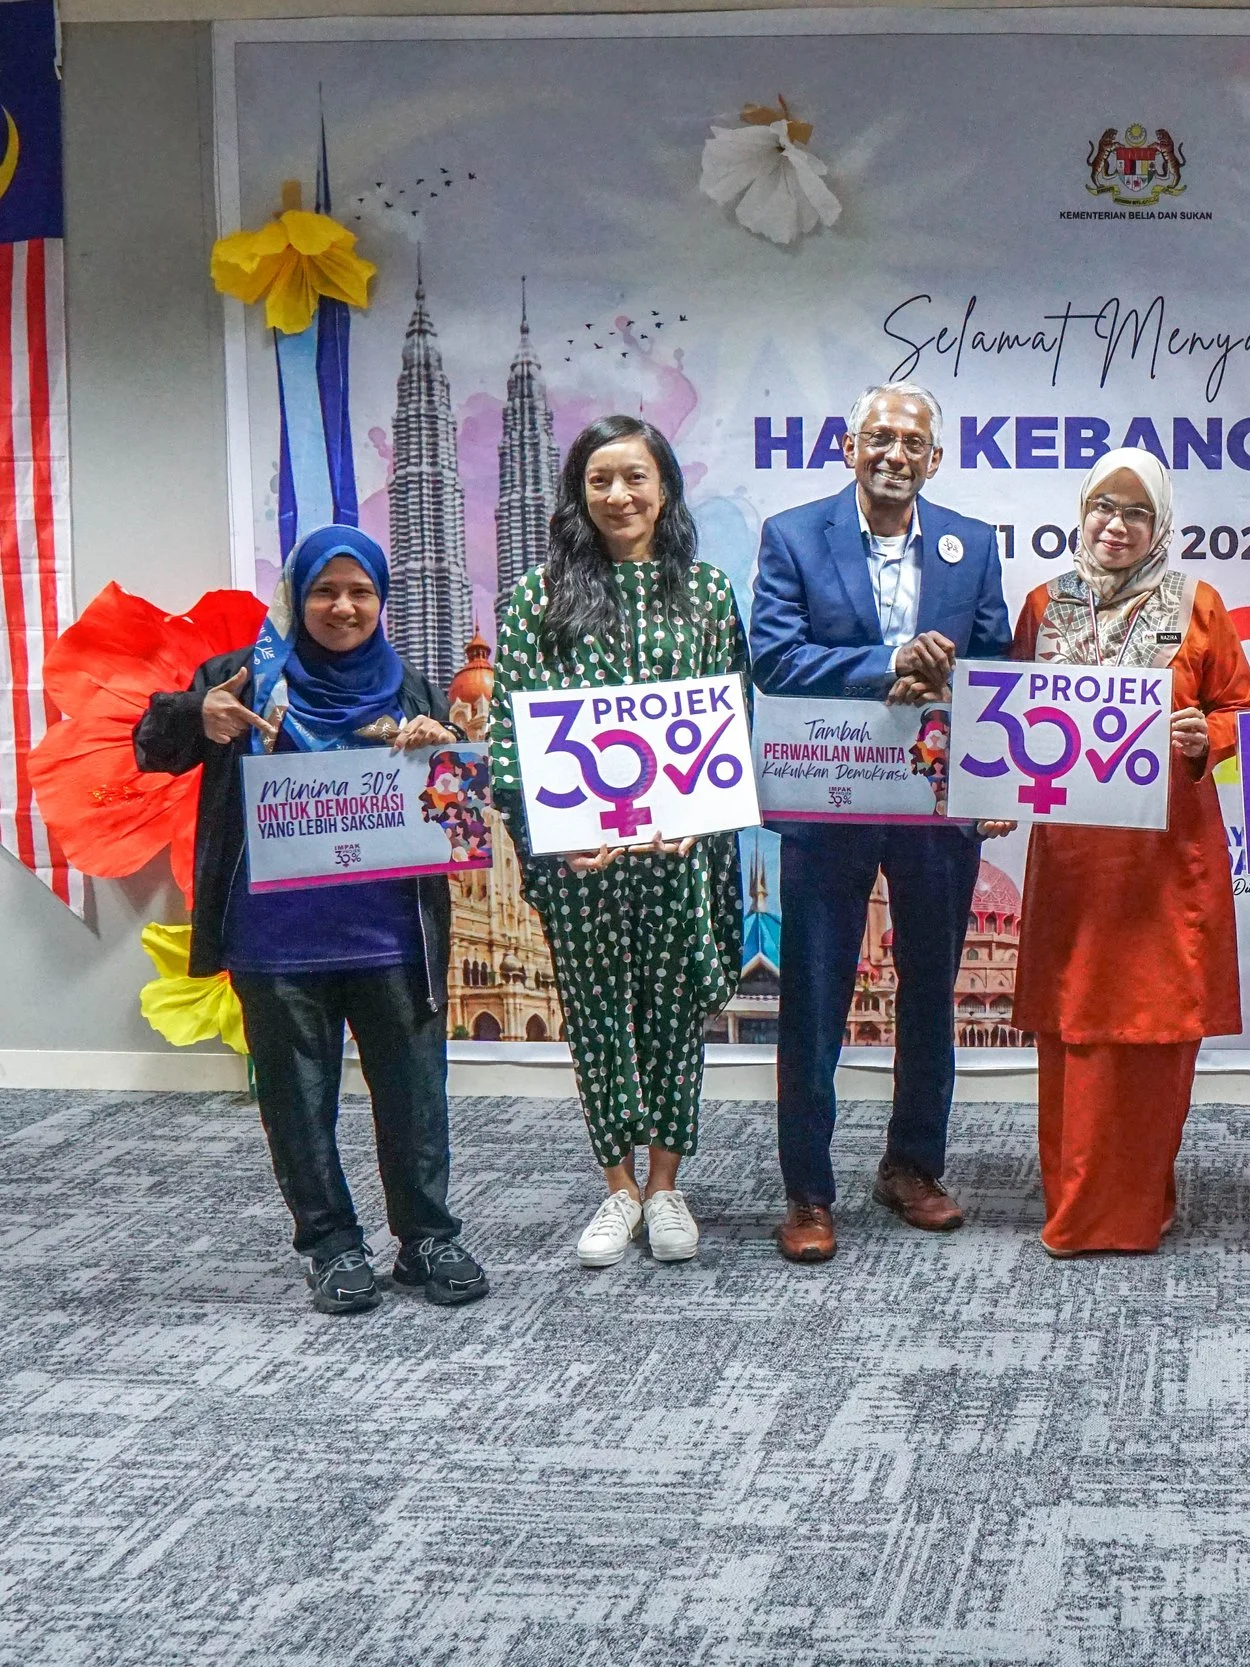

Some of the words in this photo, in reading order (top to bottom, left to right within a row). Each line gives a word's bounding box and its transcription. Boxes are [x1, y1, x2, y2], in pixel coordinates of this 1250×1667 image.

[1059, 211, 1126, 220] KEMENTERIAN
[1128, 211, 1155, 220] BELIA
[1157, 211, 1178, 220] DAN
[1180, 211, 1213, 220] SUKAN
[883, 294, 1106, 386] Selamat
[754, 416, 856, 469] HA
[992, 524, 1014, 559] 1
[592, 684, 734, 726] PROJEK
[1029, 673, 1163, 706] PROJEK
[804, 718, 872, 743] Tambah
[959, 670, 1163, 814] 30%
[529, 699, 744, 838] 30%
[763, 743, 850, 762] PERWAKILAN
[854, 746, 906, 764] WANITA
[260, 776, 349, 803] Minima
[360, 768, 400, 797] 30%
[761, 761, 829, 780] Kukuhkan
[835, 763, 909, 781] Demokrasi
[256, 800, 311, 824] UNTUK
[315, 793, 405, 819] DEMOKRASI
[258, 822, 295, 840] YANG
[298, 817, 338, 836] LEBIH
[341, 811, 406, 833] SAKSAMA
